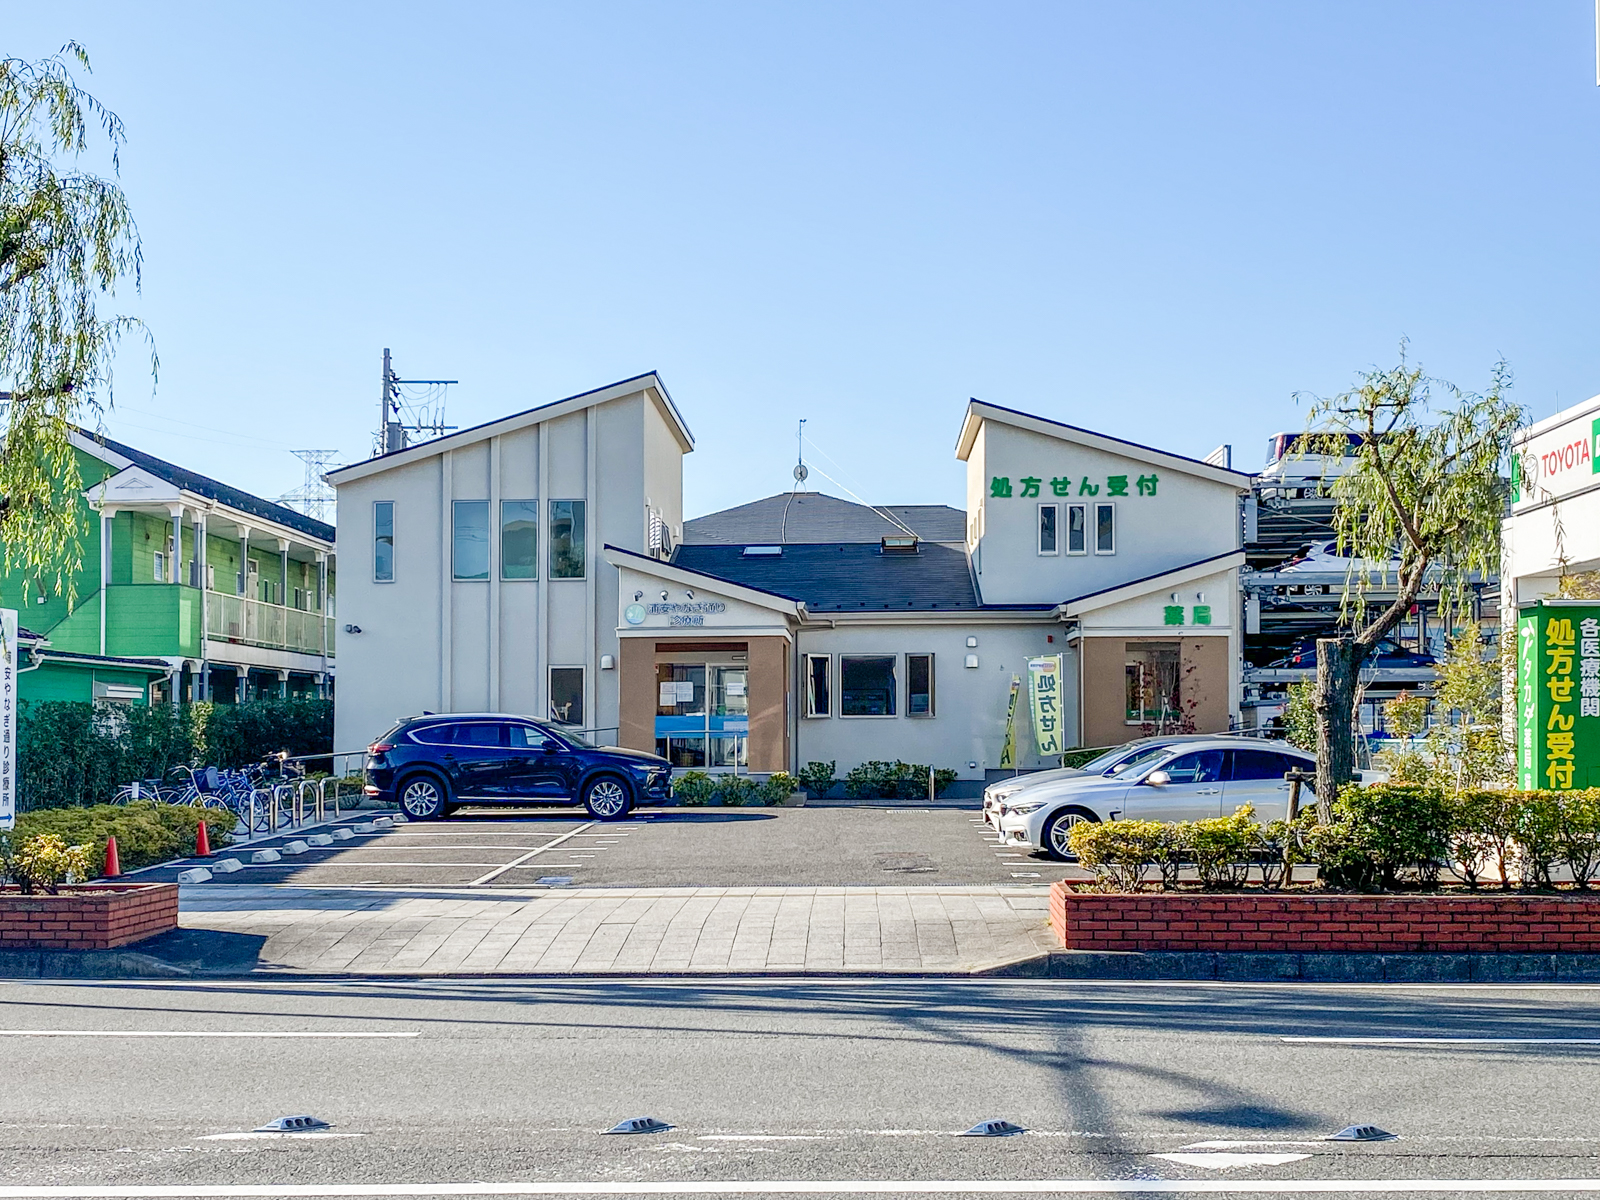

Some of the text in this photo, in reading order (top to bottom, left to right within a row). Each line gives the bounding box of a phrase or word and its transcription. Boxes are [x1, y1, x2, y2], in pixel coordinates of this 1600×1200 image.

[990, 474, 1159, 498] 処方せん受付
[1541, 438, 1590, 478] TOYOTA
[1579, 617, 1600, 717] 各医療機関
[1545, 617, 1576, 789] 処方せん受付
